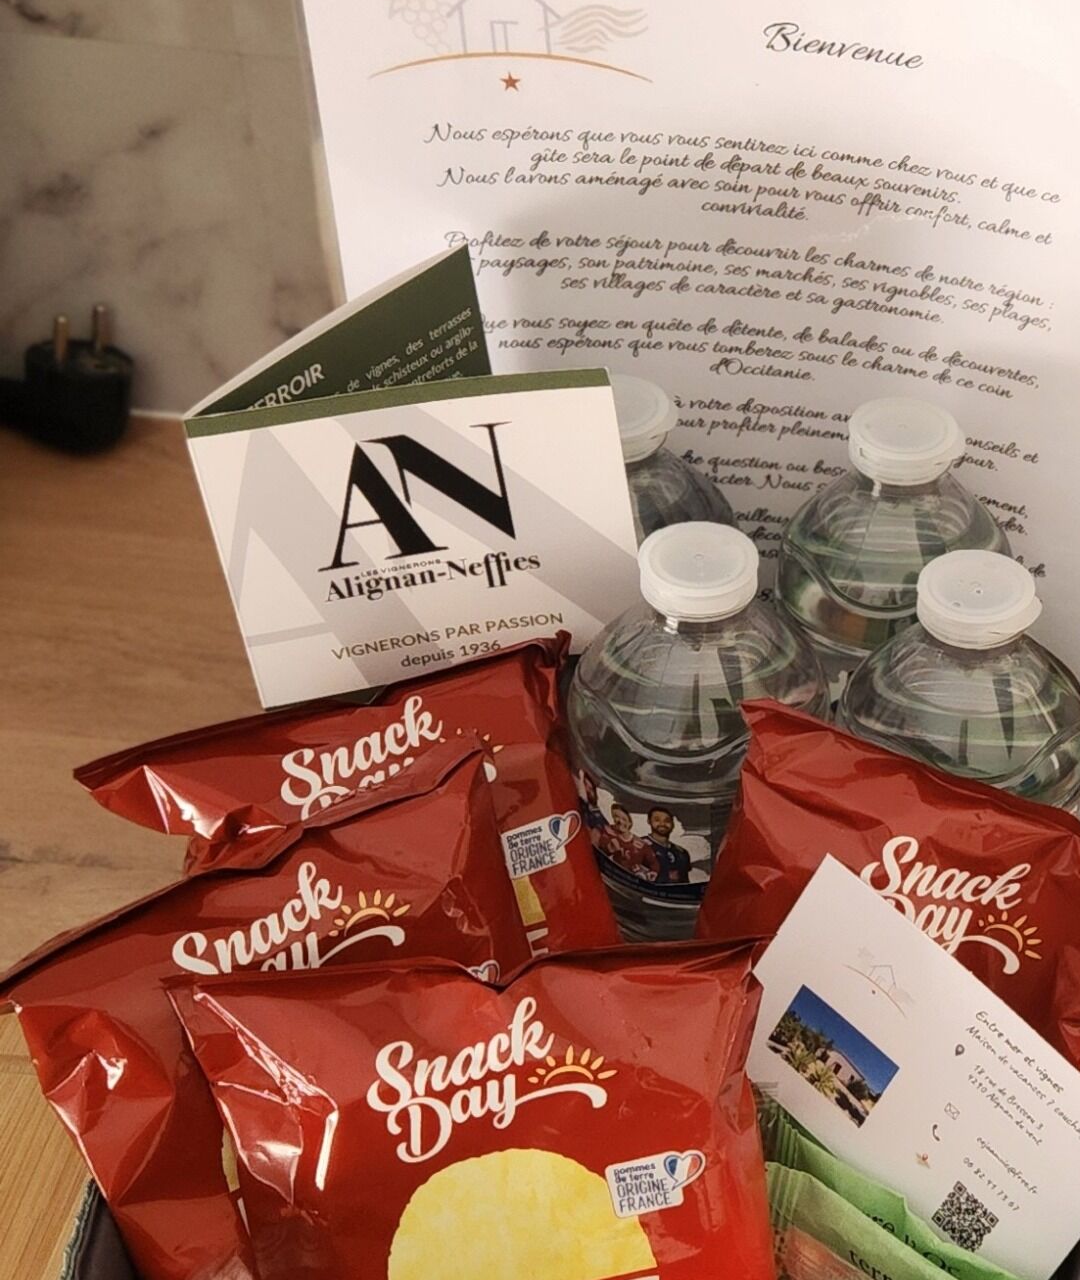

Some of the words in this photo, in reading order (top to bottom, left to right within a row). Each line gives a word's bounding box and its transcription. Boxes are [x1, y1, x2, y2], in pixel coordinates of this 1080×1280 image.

[763, 21, 924, 70] Bienvenue
[424, 122, 488, 144] Nous
[492, 125, 573, 150] espérons
[577, 129, 615, 150] que
[620, 130, 664, 147] vous
[668, 132, 708, 148] vous
[713, 135, 789, 156] sentirez
[793, 142, 817, 159] ici
[821, 148, 884, 169] comme
[888, 155, 931, 177] chez
[936, 166, 978, 186] vous
[980, 174, 1000, 191] et
[1001, 180, 1037, 202] que
[1040, 191, 1061, 204] ce
[530, 148, 569, 171] gîte
[572, 150, 615, 165] sera
[619, 147, 638, 165] le
[639, 149, 691, 175] point
[693, 151, 717, 171] de
[720, 153, 781, 182] départ
[784, 160, 807, 180] de
[811, 163, 870, 188] beaux
[873, 177, 962, 205] souvenirs.
[436, 166, 500, 188] Nous
[575, 172, 663, 196] aménagé
[667, 174, 711, 193] avec
[713, 176, 752, 195] soin
[755, 182, 801, 203] pour
[804, 188, 847, 206] vous
[850, 188, 902, 217] offrir
[976, 215, 1032, 240] calme
[1034, 230, 1053, 245] et
[701, 198, 809, 222] convivialité.
[476, 256, 573, 277] paysages,
[577, 258, 611, 271] son
[610, 257, 719, 279] patrimoine,
[723, 263, 749, 277] ses
[756, 266, 837, 289] marchés,
[842, 274, 870, 290] ses
[872, 278, 958, 309] vignobles,
[961, 297, 989, 314] ses
[988, 302, 1052, 332] plages,
[529, 230, 551, 248] de
[556, 234, 602, 249] votre
[605, 234, 663, 257] séjour
[663, 241, 712, 258] pour
[715, 238, 800, 262] découvrir
[804, 246, 831, 265] les
[833, 252, 909, 277] charmes
[914, 265, 935, 282] de
[938, 273, 985, 293] notre
[988, 283, 1044, 308] région
[560, 276, 587, 290] ses
[593, 271, 666, 298] villages
[669, 276, 691, 293] de
[695, 281, 781, 300] caractère
[785, 288, 803, 302] et
[806, 292, 829, 306] sa
[831, 296, 945, 325] gastronomie.
[346, 378, 361, 393] de
[405, 337, 425, 356] des
[428, 306, 472, 341] terrasses
[383, 352, 429, 387] schisteux
[429, 344, 444, 359] ou
[455, 346, 468, 361] de
[468, 339, 478, 352] la
[497, 336, 544, 350] nous
[546, 335, 623, 356] espérons
[627, 338, 664, 358] que
[668, 340, 707, 353] vous
[711, 340, 793, 361] tomberez
[798, 350, 837, 367] sous
[840, 351, 860, 369] le
[862, 355, 930, 381] charme
[931, 368, 954, 385] de
[955, 374, 975, 389] ce
[977, 381, 1014, 401] coin
[512, 317, 552, 330] vous
[557, 317, 611, 337] soyez
[614, 319, 639, 330] en
[641, 316, 694, 338] quête
[696, 317, 719, 334] de
[721, 318, 787, 342] détente,
[792, 325, 815, 344] de
[817, 329, 888, 354] balades
[891, 343, 915, 358] ou
[917, 346, 939, 363] de
[941, 350, 1041, 389] découvertes,
[709, 358, 815, 382] d'Occitanie.
[689, 397, 733, 412] votre
[735, 397, 828, 422] disposition
[708, 416, 777, 438] profiter
[707, 454, 783, 474] question
[786, 461, 809, 473] ou
[965, 436, 1022, 459] onseils
[1022, 452, 1039, 464] et
[318, 421, 516, 572] AN
[756, 474, 814, 492] Nous
[325, 551, 541, 602] Alignan-Neffies
[380, 558, 442, 575] VIGNERONS
[330, 629, 441, 660] VIGNERONS
[445, 622, 482, 640] PAR
[485, 612, 564, 633] PASSION
[401, 648, 455, 668] depuis
[459, 639, 502, 657] 1936
[280, 695, 442, 806] Snack
[509, 838, 555, 863] ORIGINE
[512, 850, 557, 876] FRANCE
[860, 835, 1031, 910] Snack
[171, 860, 343, 975] Snack
[366, 996, 556, 1113] Snack
[965, 1025, 997, 1056] Maison
[998, 1054, 1009, 1065] de
[1009, 1064, 1047, 1101] vacances
[975, 1010, 1004, 1039] Entre
[1004, 1038, 1023, 1055] mer
[1023, 1055, 1036, 1067] et
[1035, 1065, 1065, 1094] vignes
[984, 1074, 997, 1088] rue
[997, 1087, 1008, 1098] de
[386, 1073, 608, 1163] Day
[986, 1092, 1014, 1120] Alignan
[1025, 1128, 1043, 1147] vent
[616, 1178, 669, 1199] ORIGINE
[619, 1191, 672, 1213] FRANCE
